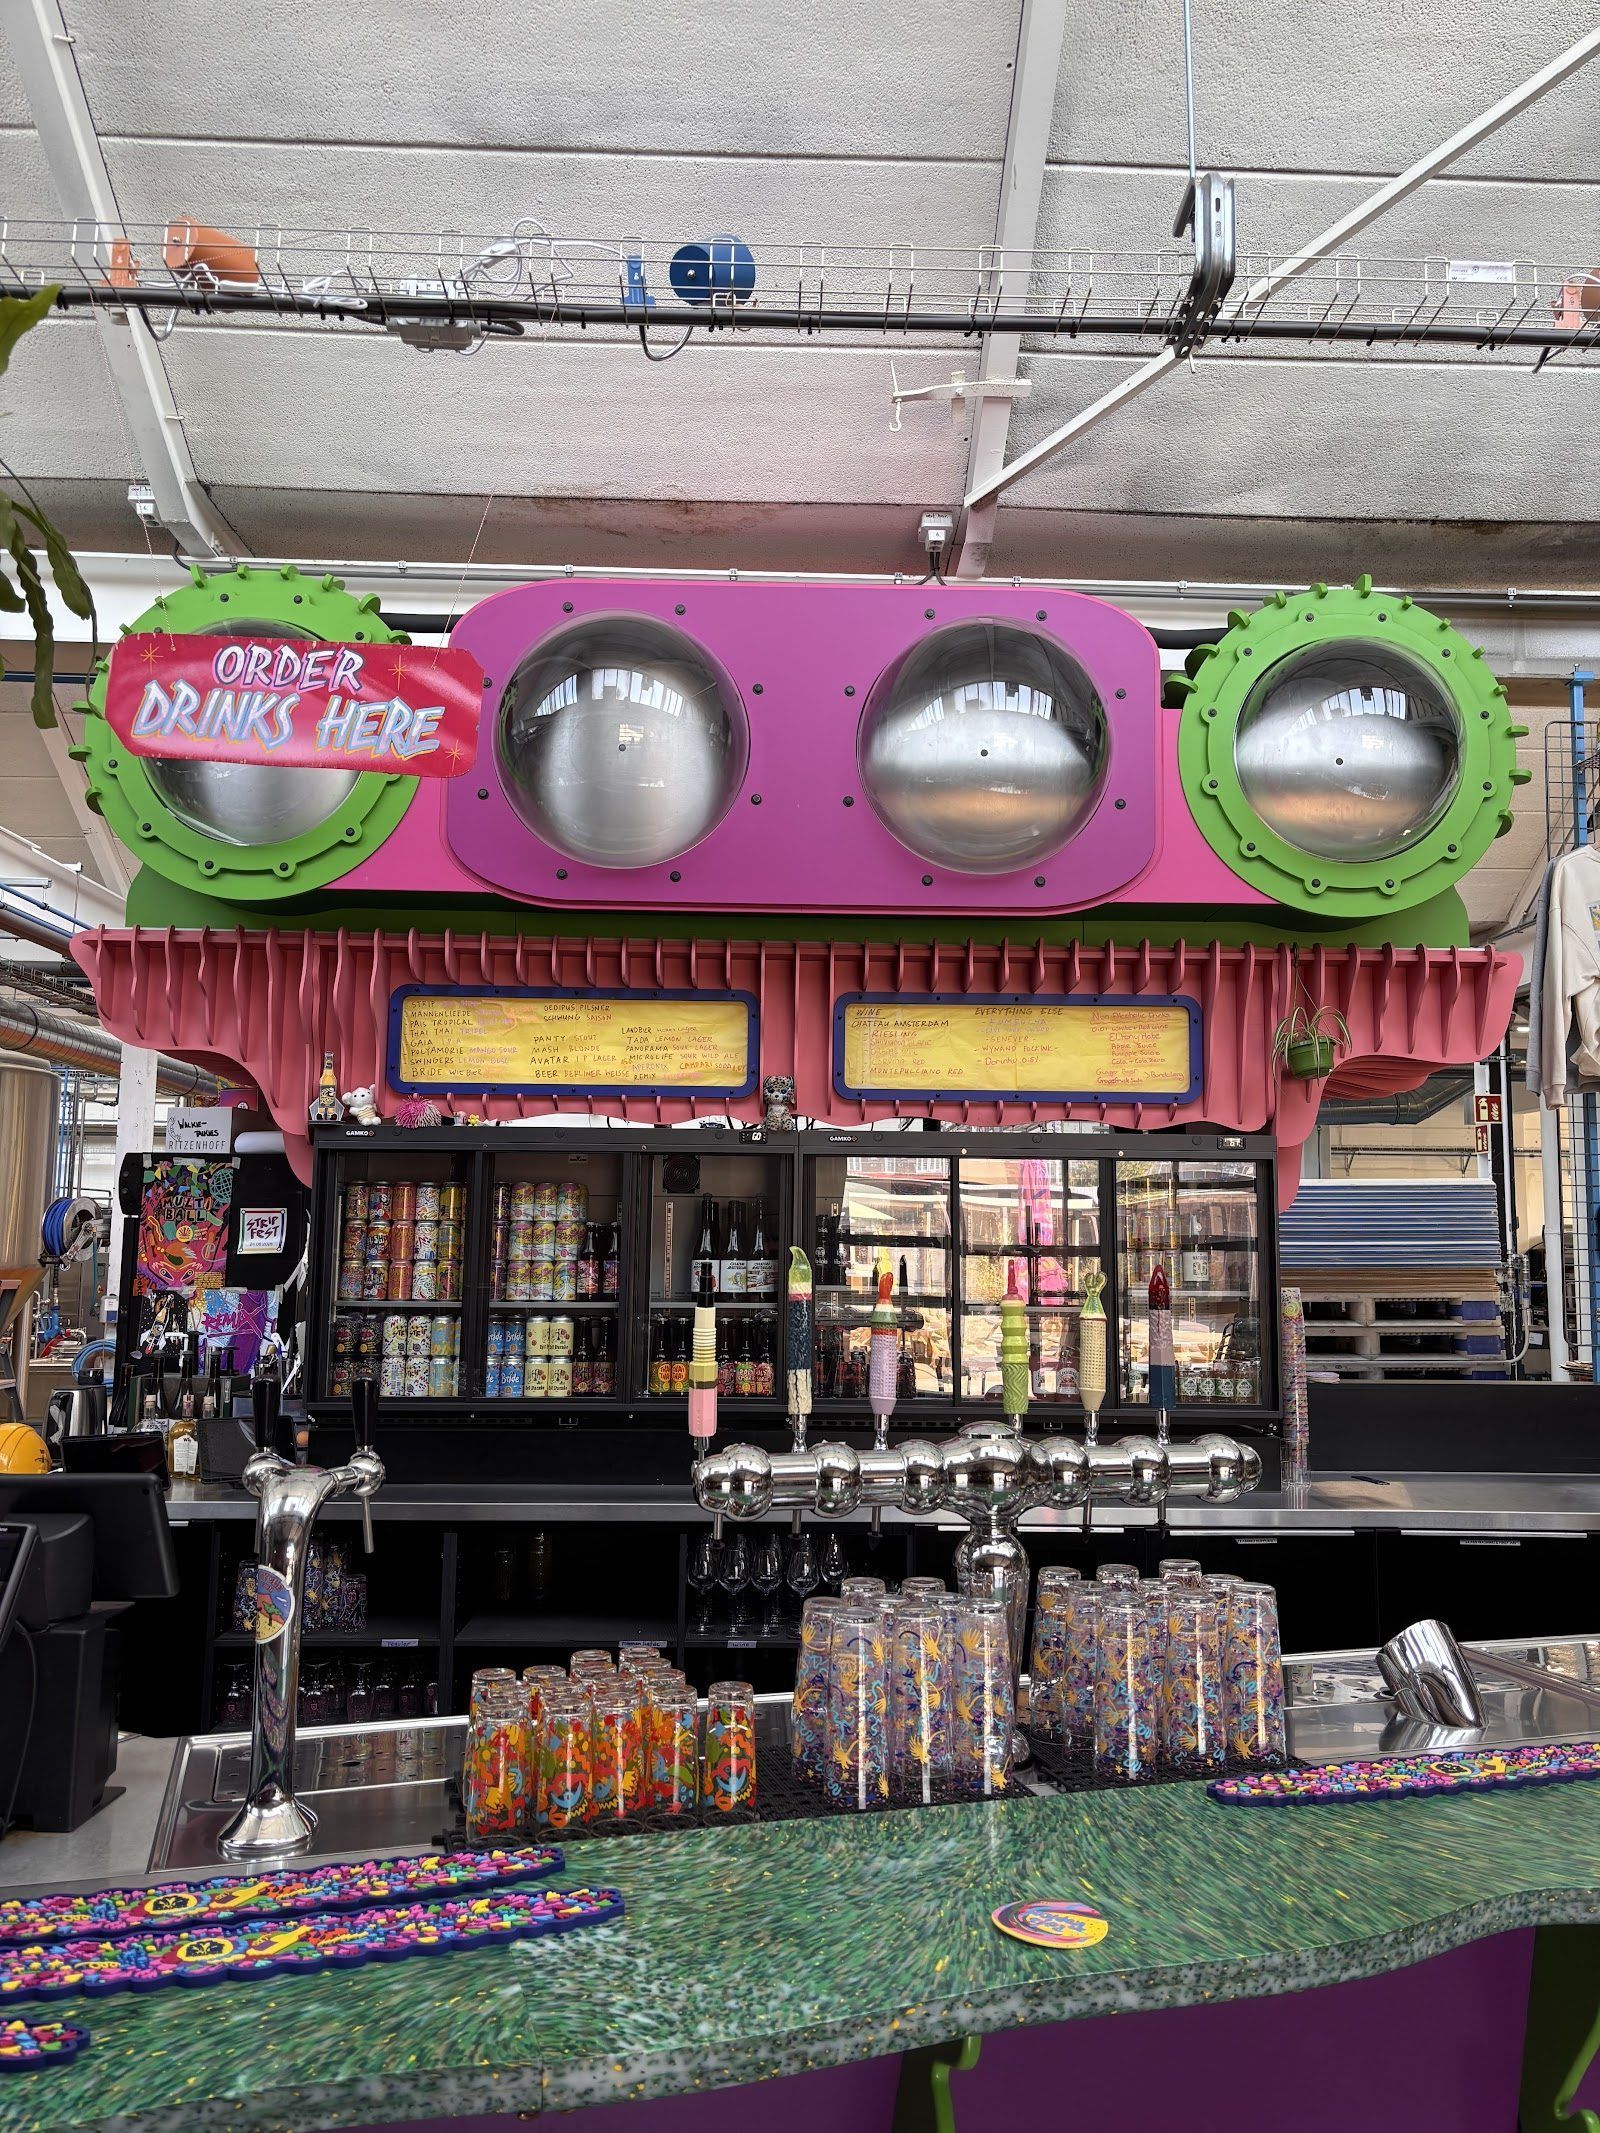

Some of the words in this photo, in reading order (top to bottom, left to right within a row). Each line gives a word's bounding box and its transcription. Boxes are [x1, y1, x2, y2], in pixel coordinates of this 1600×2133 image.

[212, 644, 364, 693] ORDER
[132, 679, 300, 751] DRINKS
[315, 694, 446, 760] HERE
[544, 1003, 575, 1012] OEDIPUS
[580, 1004, 611, 1012] PILSNER
[856, 1008, 883, 1016] WINE
[975, 1007, 1033, 1016] EVERYTHING
[1040, 1007, 1064, 1016] ELSE
[433, 1018, 473, 1026] TROPICAL
[543, 1014, 581, 1022] SCHWUNG
[851, 1020, 889, 1028] CHATEAU
[894, 1019, 949, 1027] AMSTERDAM
[410, 1039, 433, 1047] GAIA
[533, 1035, 566, 1043] PANTY
[627, 1036, 649, 1044] TADA
[411, 1047, 464, 1056] POLYAMORIE
[532, 1046, 559, 1054] MASH
[410, 1057, 454, 1065] SWINGERS
[530, 1056, 569, 1065] AVATAR
[412, 1068, 442, 1077] BRIDE
[535, 1069, 559, 1078] BEER
[168, 1140, 226, 1150] RITZENHOFF
[164, 1209, 207, 1222] BALL
[246, 1215, 279, 1231] STRIP
